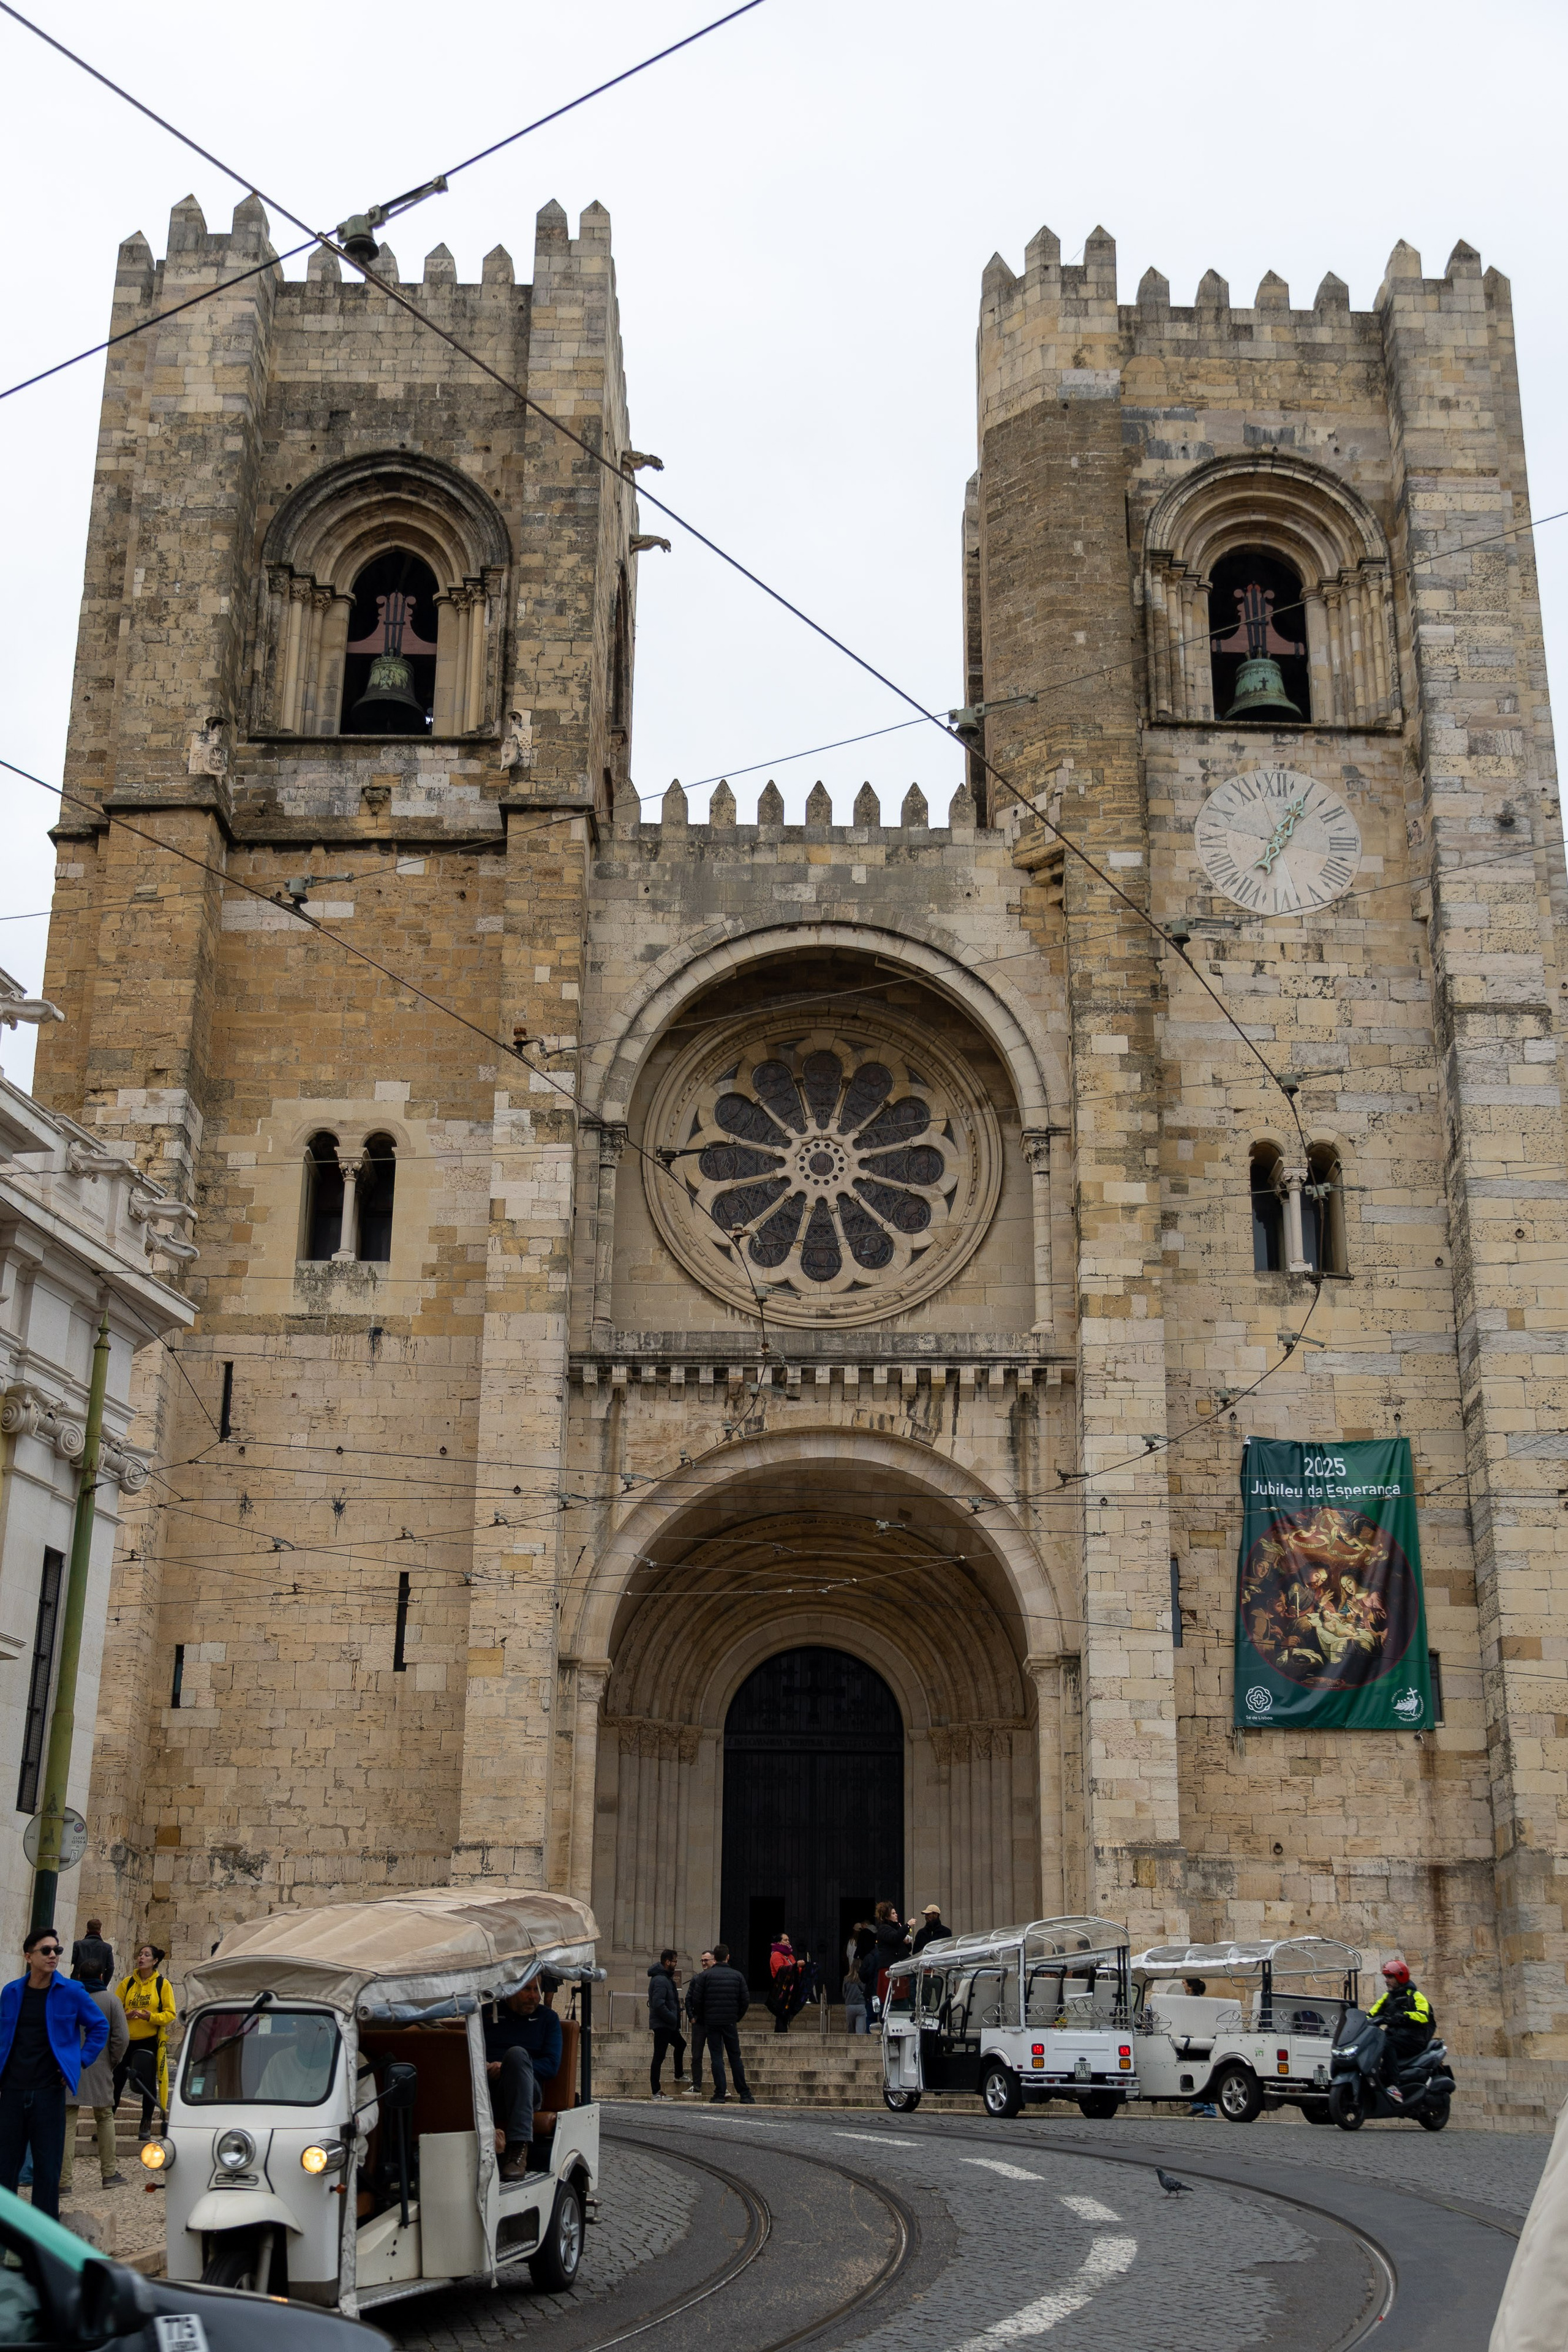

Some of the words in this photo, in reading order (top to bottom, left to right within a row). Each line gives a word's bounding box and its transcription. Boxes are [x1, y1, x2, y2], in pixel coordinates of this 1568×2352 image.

[1229, 777, 1257, 806] XI
[1263, 772, 1288, 798] XII
[1206, 801, 1236, 823] X
[1318, 805, 1346, 825] II
[1329, 836, 1357, 853] III
[1205, 853, 1240, 889] VIII
[1233, 876, 1262, 908] VII
[1304, 1457, 1346, 1478] 2025
[1251, 1480, 1303, 1498] Jubileu
[1308, 1483, 1323, 1498] da
